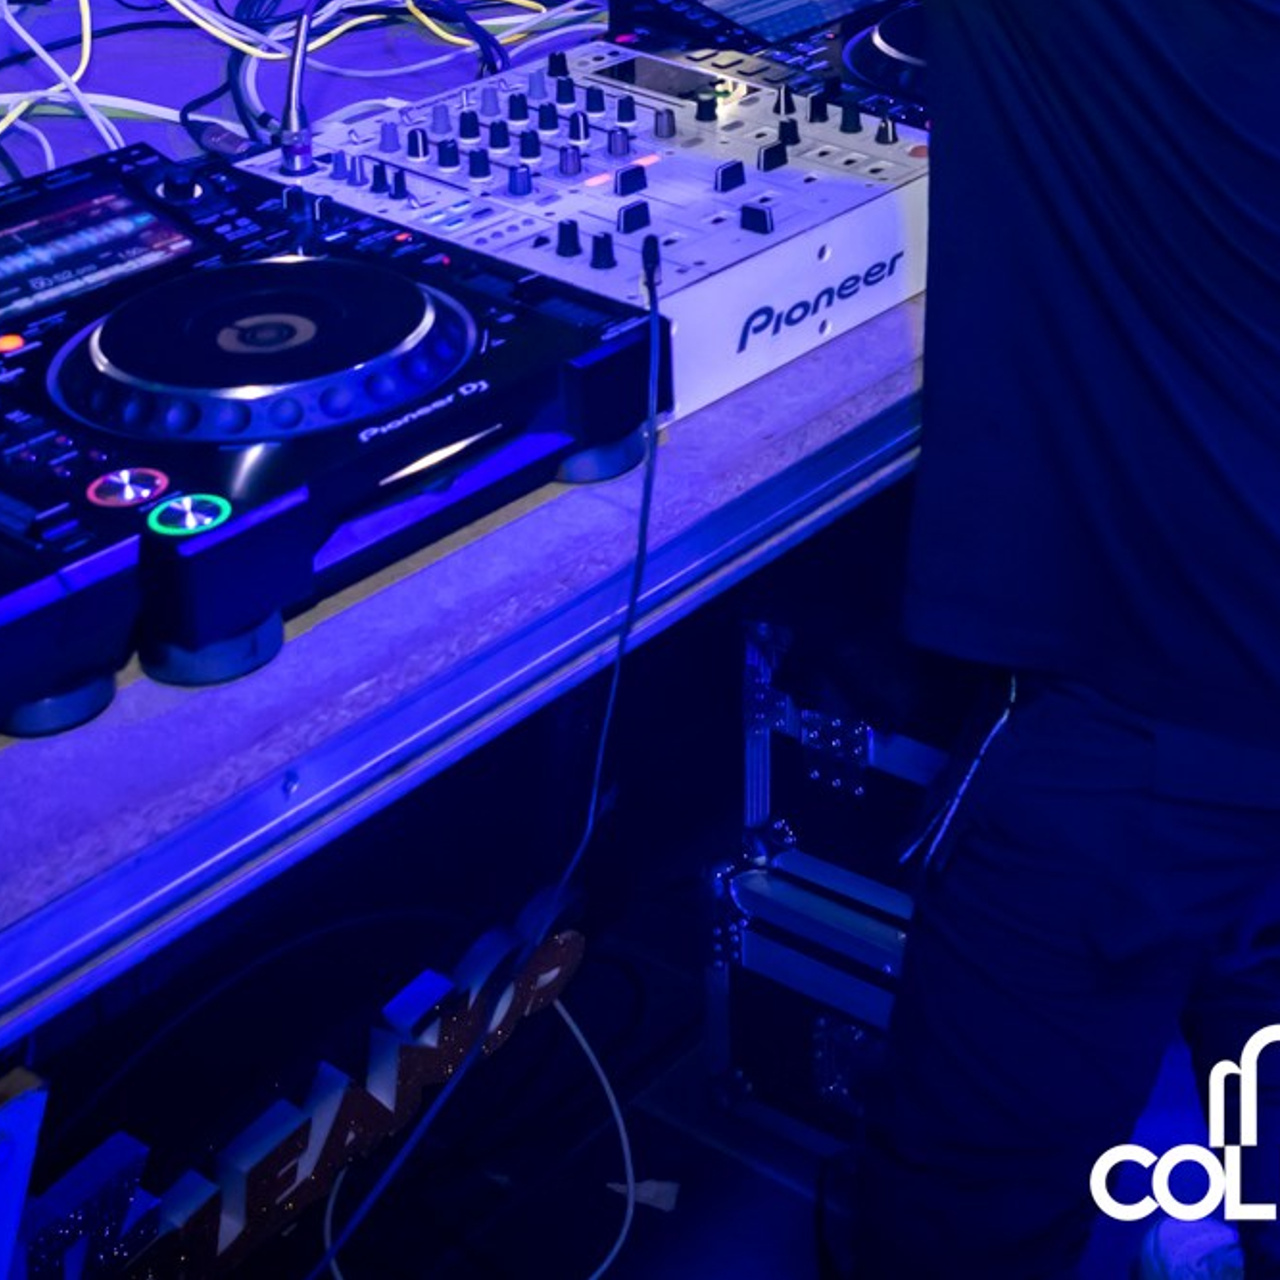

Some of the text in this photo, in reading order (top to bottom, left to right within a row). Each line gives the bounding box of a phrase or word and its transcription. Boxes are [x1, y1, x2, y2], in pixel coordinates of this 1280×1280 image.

[736, 250, 905, 354] Pioneer
[358, 378, 490, 443] Pioneer DJ
